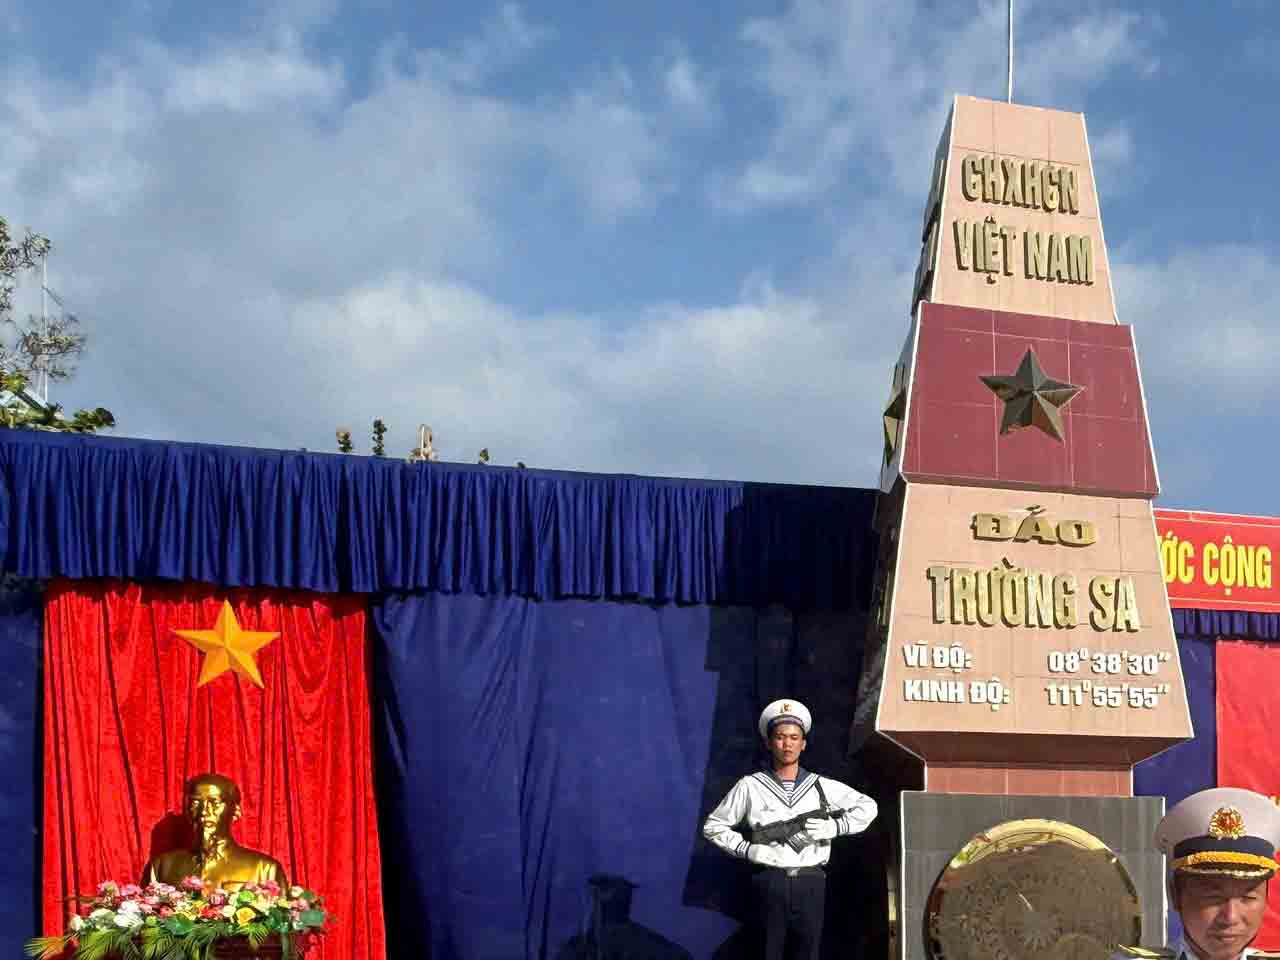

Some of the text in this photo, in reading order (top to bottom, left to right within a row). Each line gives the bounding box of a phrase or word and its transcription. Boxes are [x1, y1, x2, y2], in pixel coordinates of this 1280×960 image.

[962, 154, 1079, 215] CHXHCN
[953, 216, 1093, 286] VIỆT NAM
[970, 505, 1097, 547] ĐẢO
[1158, 531, 1195, 584] ỚC
[1203, 535, 1272, 595] CỘNG
[927, 557, 1140, 632] TRƯỜNG SA
[932, 643, 972, 673] ĐỘ:
[903, 677, 1010, 711] KINH ĐỘ:
